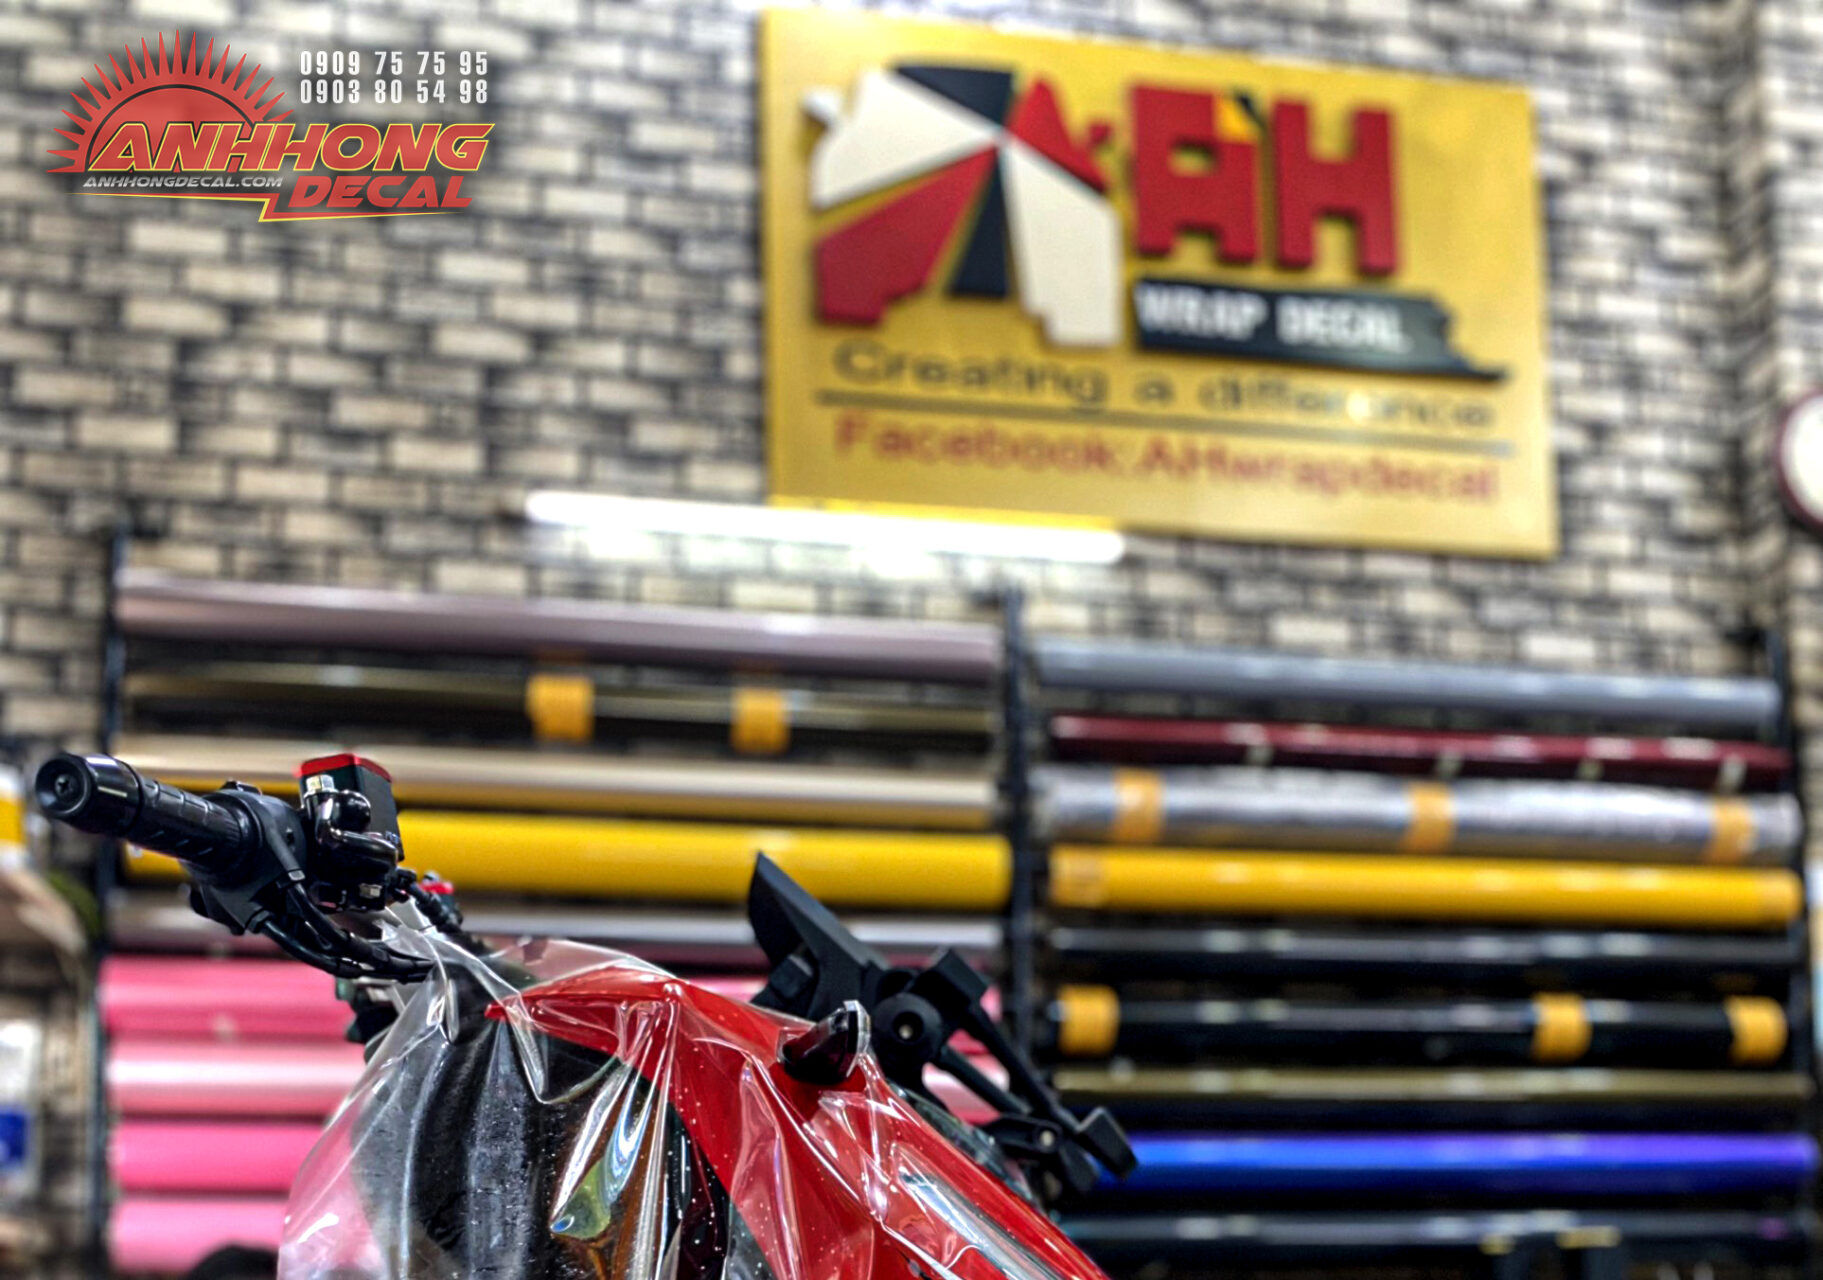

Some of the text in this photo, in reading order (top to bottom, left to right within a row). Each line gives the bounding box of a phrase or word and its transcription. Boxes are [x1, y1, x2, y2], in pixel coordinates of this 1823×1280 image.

[833, 339, 1496, 429] Creating a differnce
